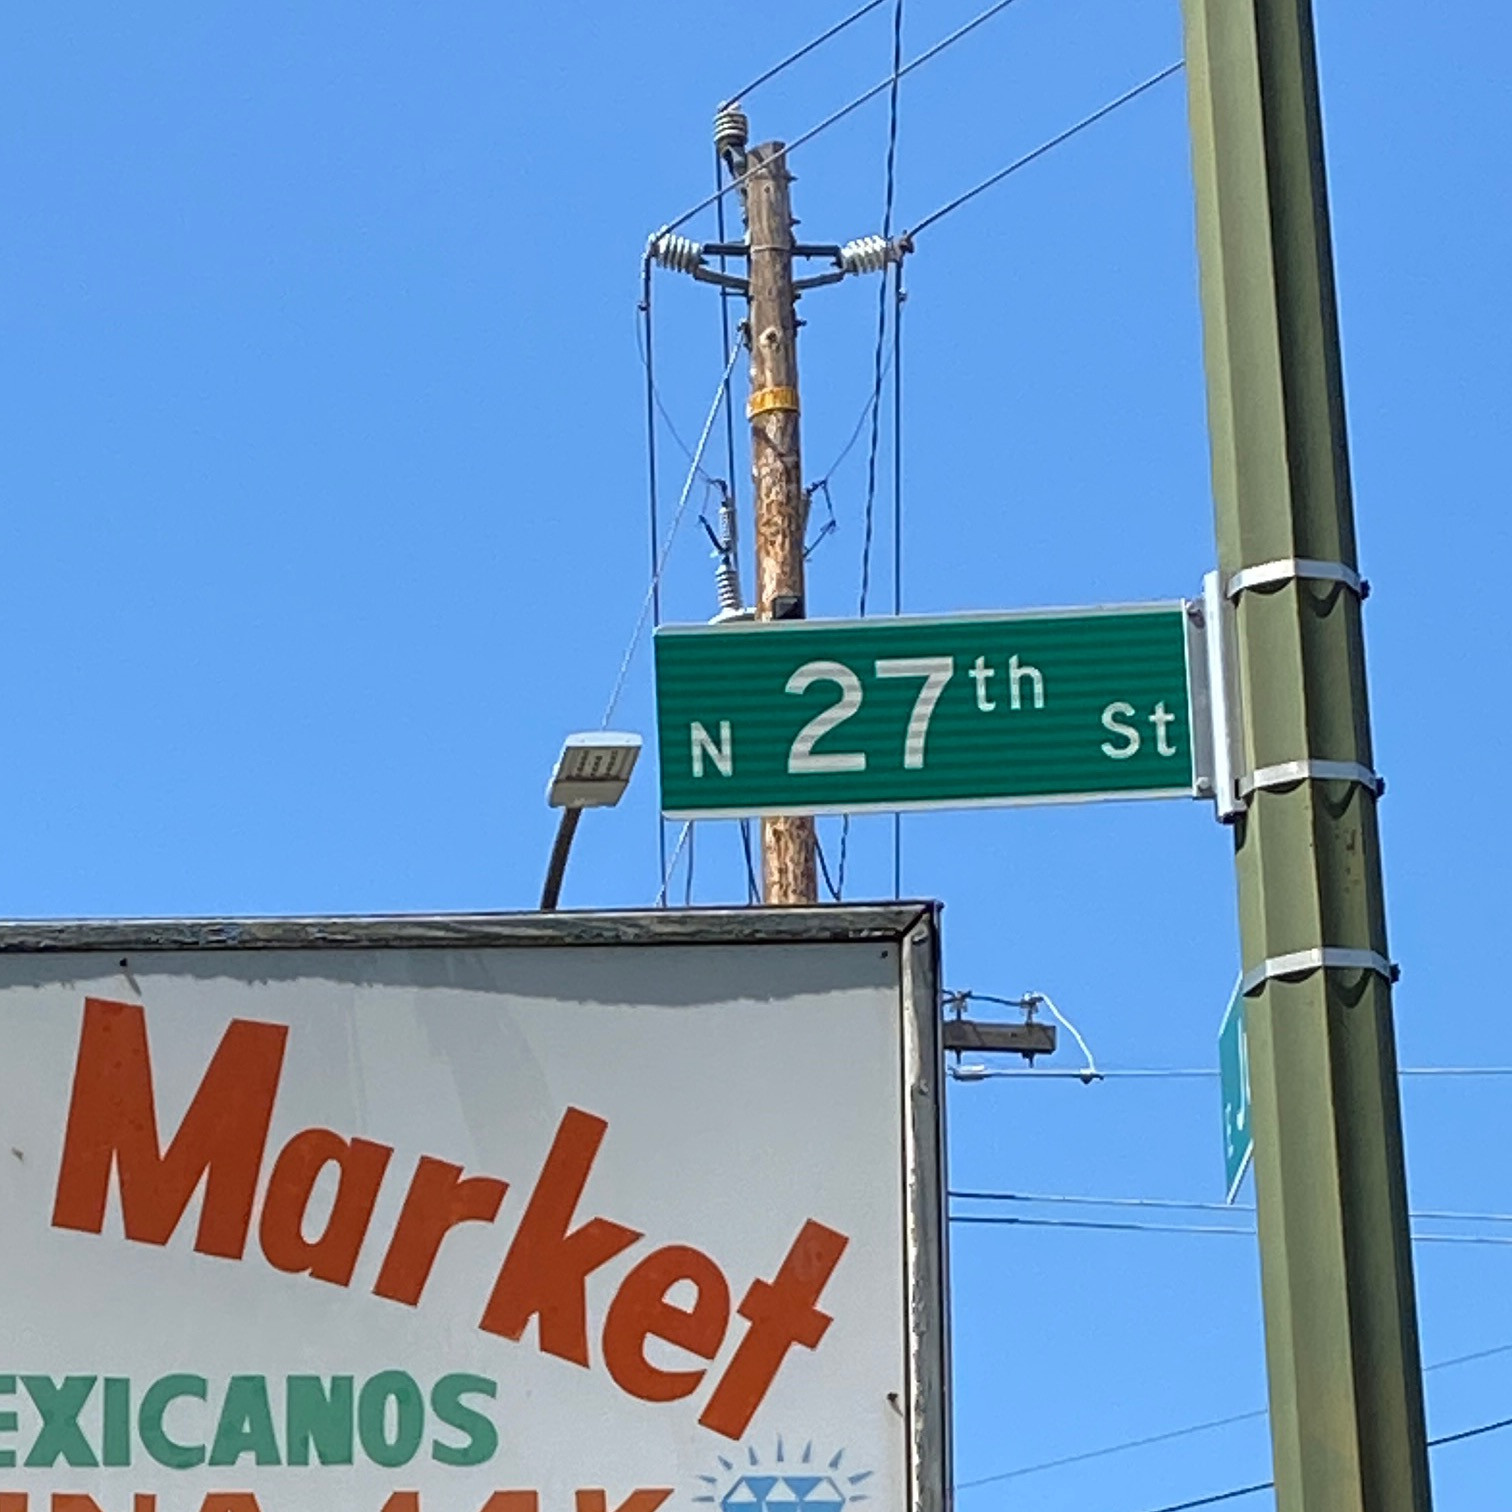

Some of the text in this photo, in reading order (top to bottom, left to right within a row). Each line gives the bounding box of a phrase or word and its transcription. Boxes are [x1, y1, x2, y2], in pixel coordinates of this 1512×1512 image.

[690, 654, 1177, 778] N 27th St
[51, 996, 849, 1441] Market
